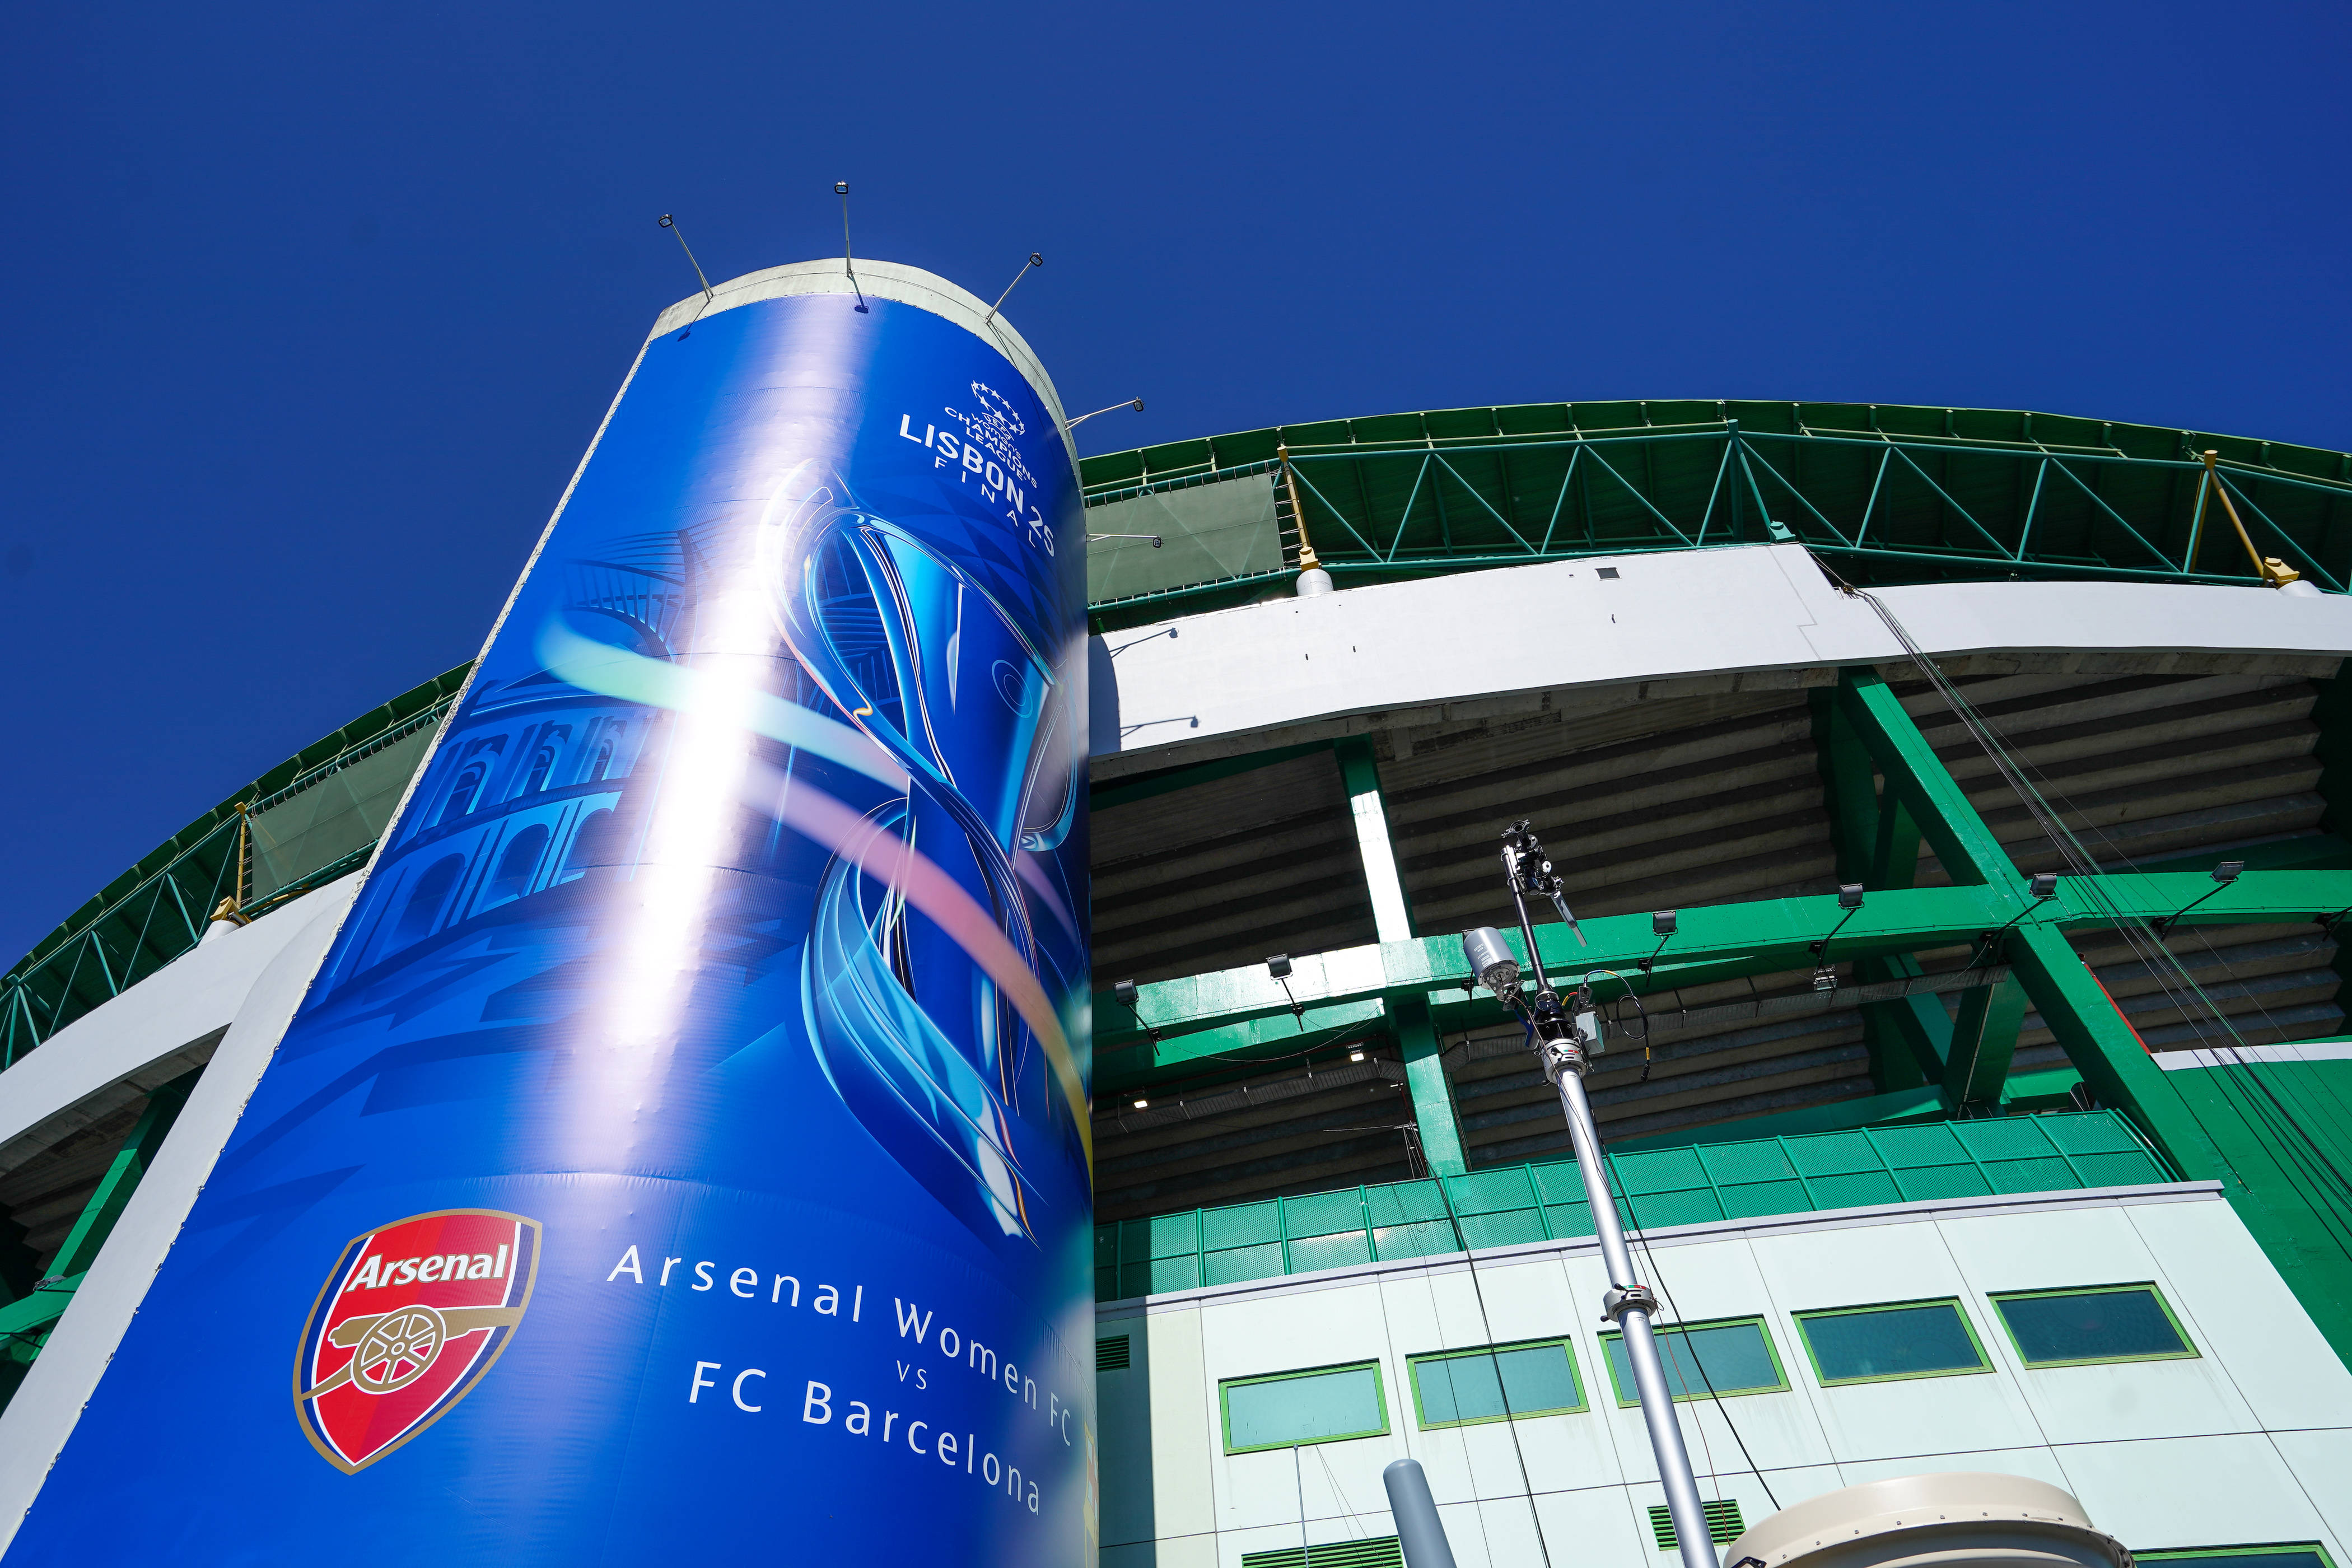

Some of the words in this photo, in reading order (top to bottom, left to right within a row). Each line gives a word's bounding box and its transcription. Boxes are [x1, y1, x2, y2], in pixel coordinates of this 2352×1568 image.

[944, 407, 1037, 488] CHAMPIONS
[966, 426, 1023, 481] LEAGUE
[983, 414, 1011, 440] UEFA
[899, 413, 1024, 514] LISBON
[1028, 505, 1054, 557] 25
[935, 456, 1036, 548] FINAL
[344, 1243, 509, 1293] Arsenal
[606, 1244, 864, 1323] Arsenal
[894, 1297, 1038, 1411] Women
[1050, 1392, 1071, 1446] FC
[689, 1360, 767, 1413] FC
[802, 1380, 1040, 1516] Barcelona
